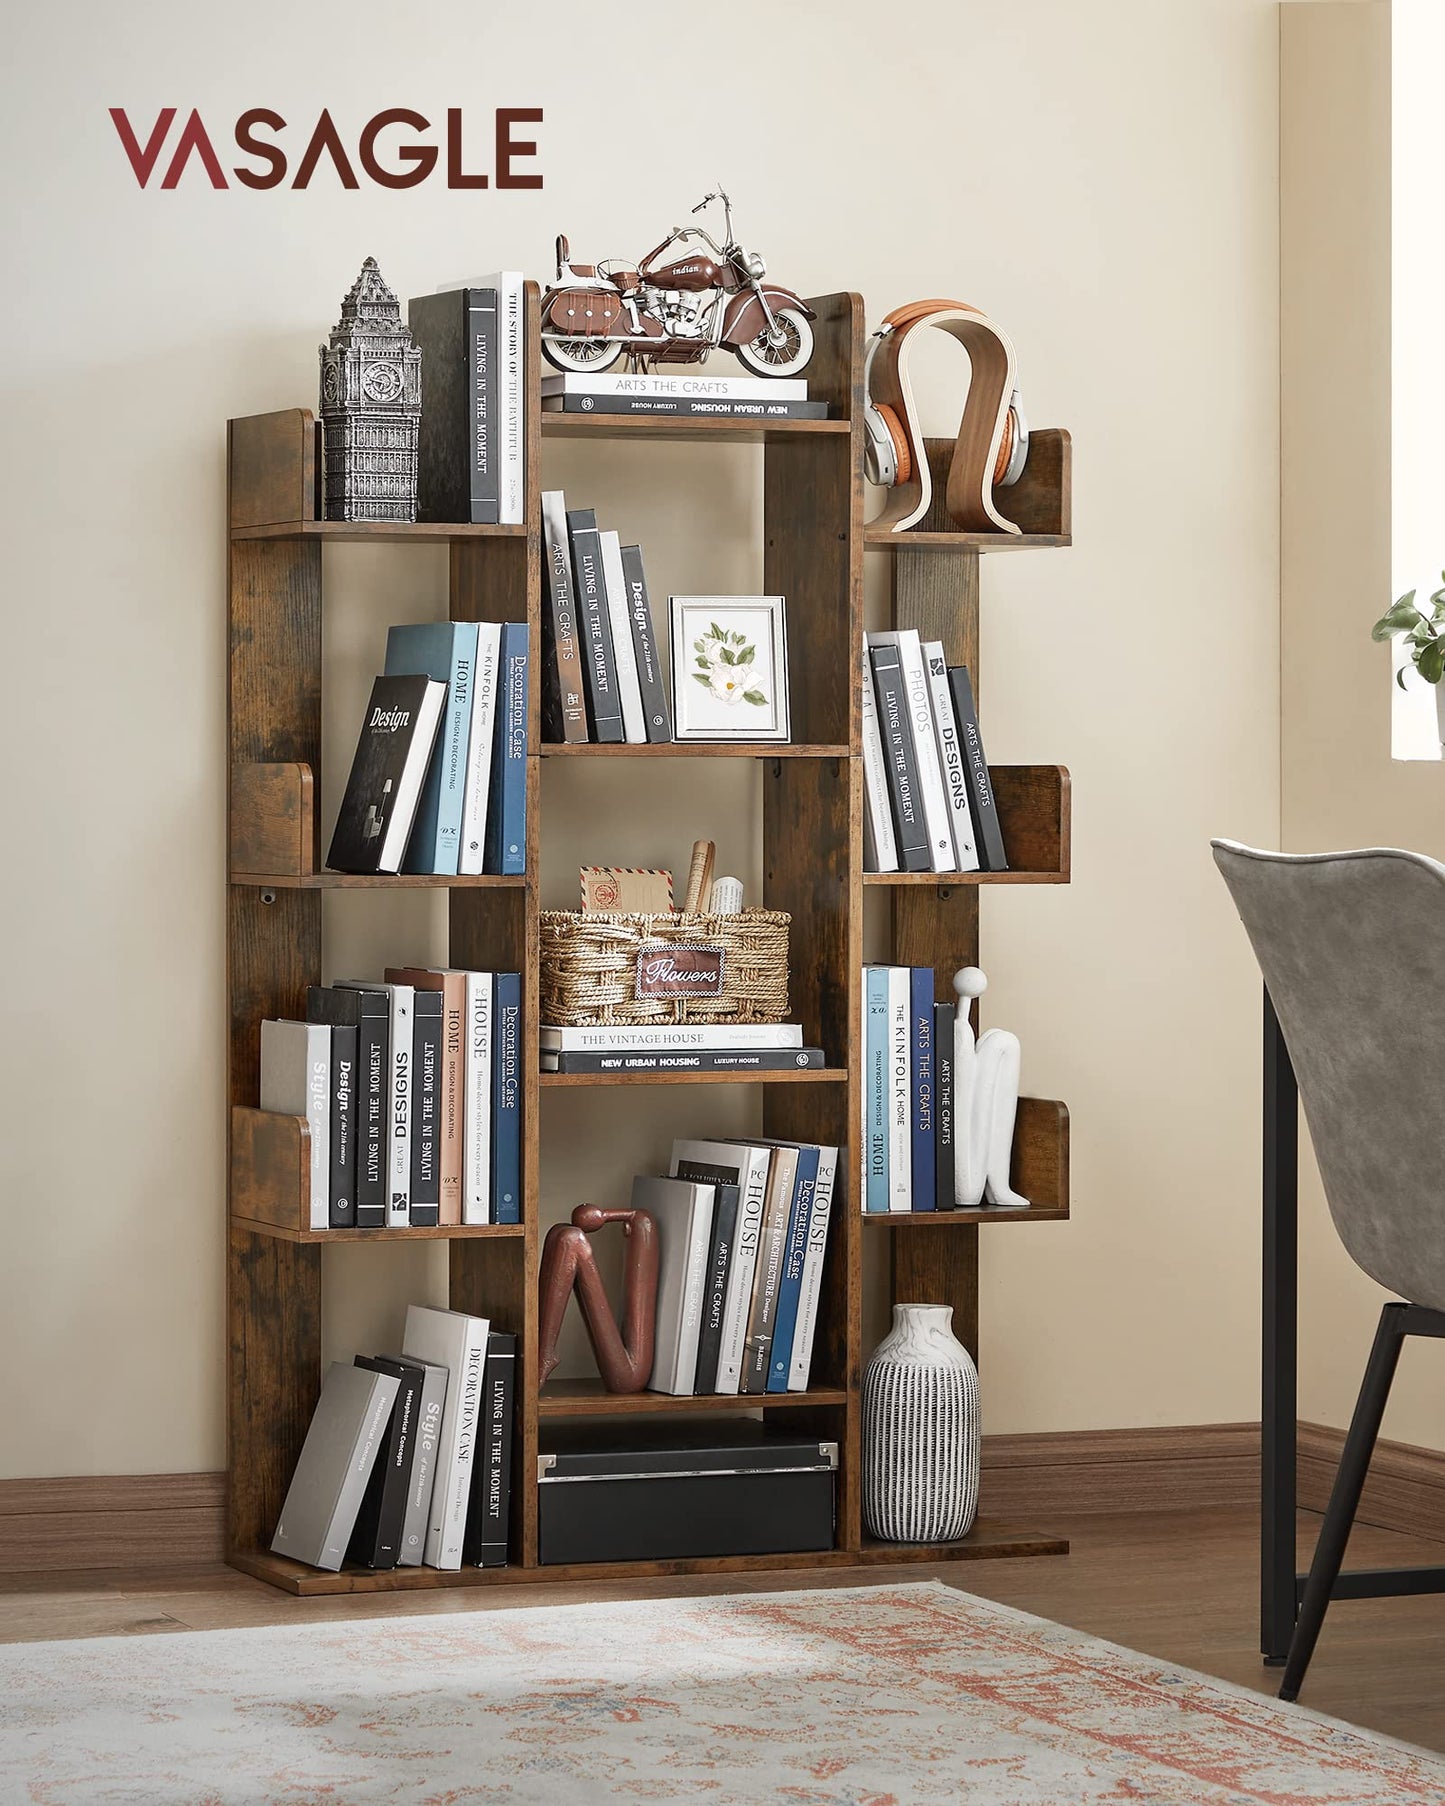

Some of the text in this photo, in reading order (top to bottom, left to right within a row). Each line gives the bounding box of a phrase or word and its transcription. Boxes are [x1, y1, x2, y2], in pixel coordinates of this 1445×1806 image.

[508, 292, 517, 318] THE
[508, 320, 517, 358] STORY
[508, 361, 517, 376] OF
[509, 380, 517, 403] THE
[616, 379, 728, 394] ARTS THE CRAFTS
[476, 334, 487, 474] LIVING IN THE MOMENT
[691, 403, 788, 414] NEW URBAN HOUSING
[553, 544, 574, 660] ARTS THE CRAFTS
[583, 555, 608, 692] LIVING IN THE MOMENT
[632, 582, 648, 631] Design
[482, 656, 493, 709] KINFOLK
[512, 656, 527, 760] Decoration Case
[909, 669, 930, 734] PHOTOS
[370, 704, 411, 732] Design
[449, 660, 470, 790] HOME DESIGN & DECORATING
[885, 690, 914, 824] LIVING IN THE MOMENT
[938, 693, 966, 810] GREAT DESIGNS
[966, 722, 990, 807] ARTS THE CRAFTS
[646, 958, 718, 984] Flowers
[448, 1010, 460, 1054] HOME
[473, 998, 488, 1060] HOUSE
[580, 1034, 704, 1046] THE VINTAGE HOUSE
[337, 1060, 352, 1112] Design
[476, 1070, 484, 1090] Home
[506, 1006, 518, 1110] Decoration Case
[601, 1058, 700, 1068] NEW URBAN HOUSING
[896, 1027, 906, 1098] KINFOLK
[919, 1018, 930, 1131] ARTS THE CRAFTS
[312, 1062, 327, 1112] Style
[368, 1043, 381, 1182] LIVING IN THE MOMENT
[394, 1052, 408, 1138] DESIGNS
[422, 1042, 435, 1182] LIVING IN THE MOMENT
[476, 1091, 484, 1110] decor
[897, 1100, 905, 1126] HOME
[942, 1060, 950, 1146] ARTS THE CRAFTS
[340, 1114, 346, 1122] of
[338, 1144, 346, 1166] century
[750, 1170, 766, 1179] PC
[782, 1168, 791, 1181] The
[818, 1167, 833, 1177] PC
[873, 1133, 884, 1176] HOME
[741, 1184, 763, 1257] HOUSE
[774, 1212, 786, 1228] ART
[790, 1179, 814, 1280] Decoration Case
[809, 1182, 831, 1254] HOUSE
[687, 1239, 704, 1327] ARTS THE CRAFTS
[710, 1241, 728, 1328] ARTS THE CRAFTS
[766, 1235, 783, 1296] ARCHITECTURE
[762, 1298, 770, 1323] Designer
[357, 1396, 387, 1471] Metaphorical Concepts
[396, 1389, 414, 1468] Metaphorical Concepts
[422, 1402, 440, 1450] Style
[457, 1348, 481, 1464] DECORATION CASE
[489, 1380, 504, 1518] LIVING IN THE MOMENT
